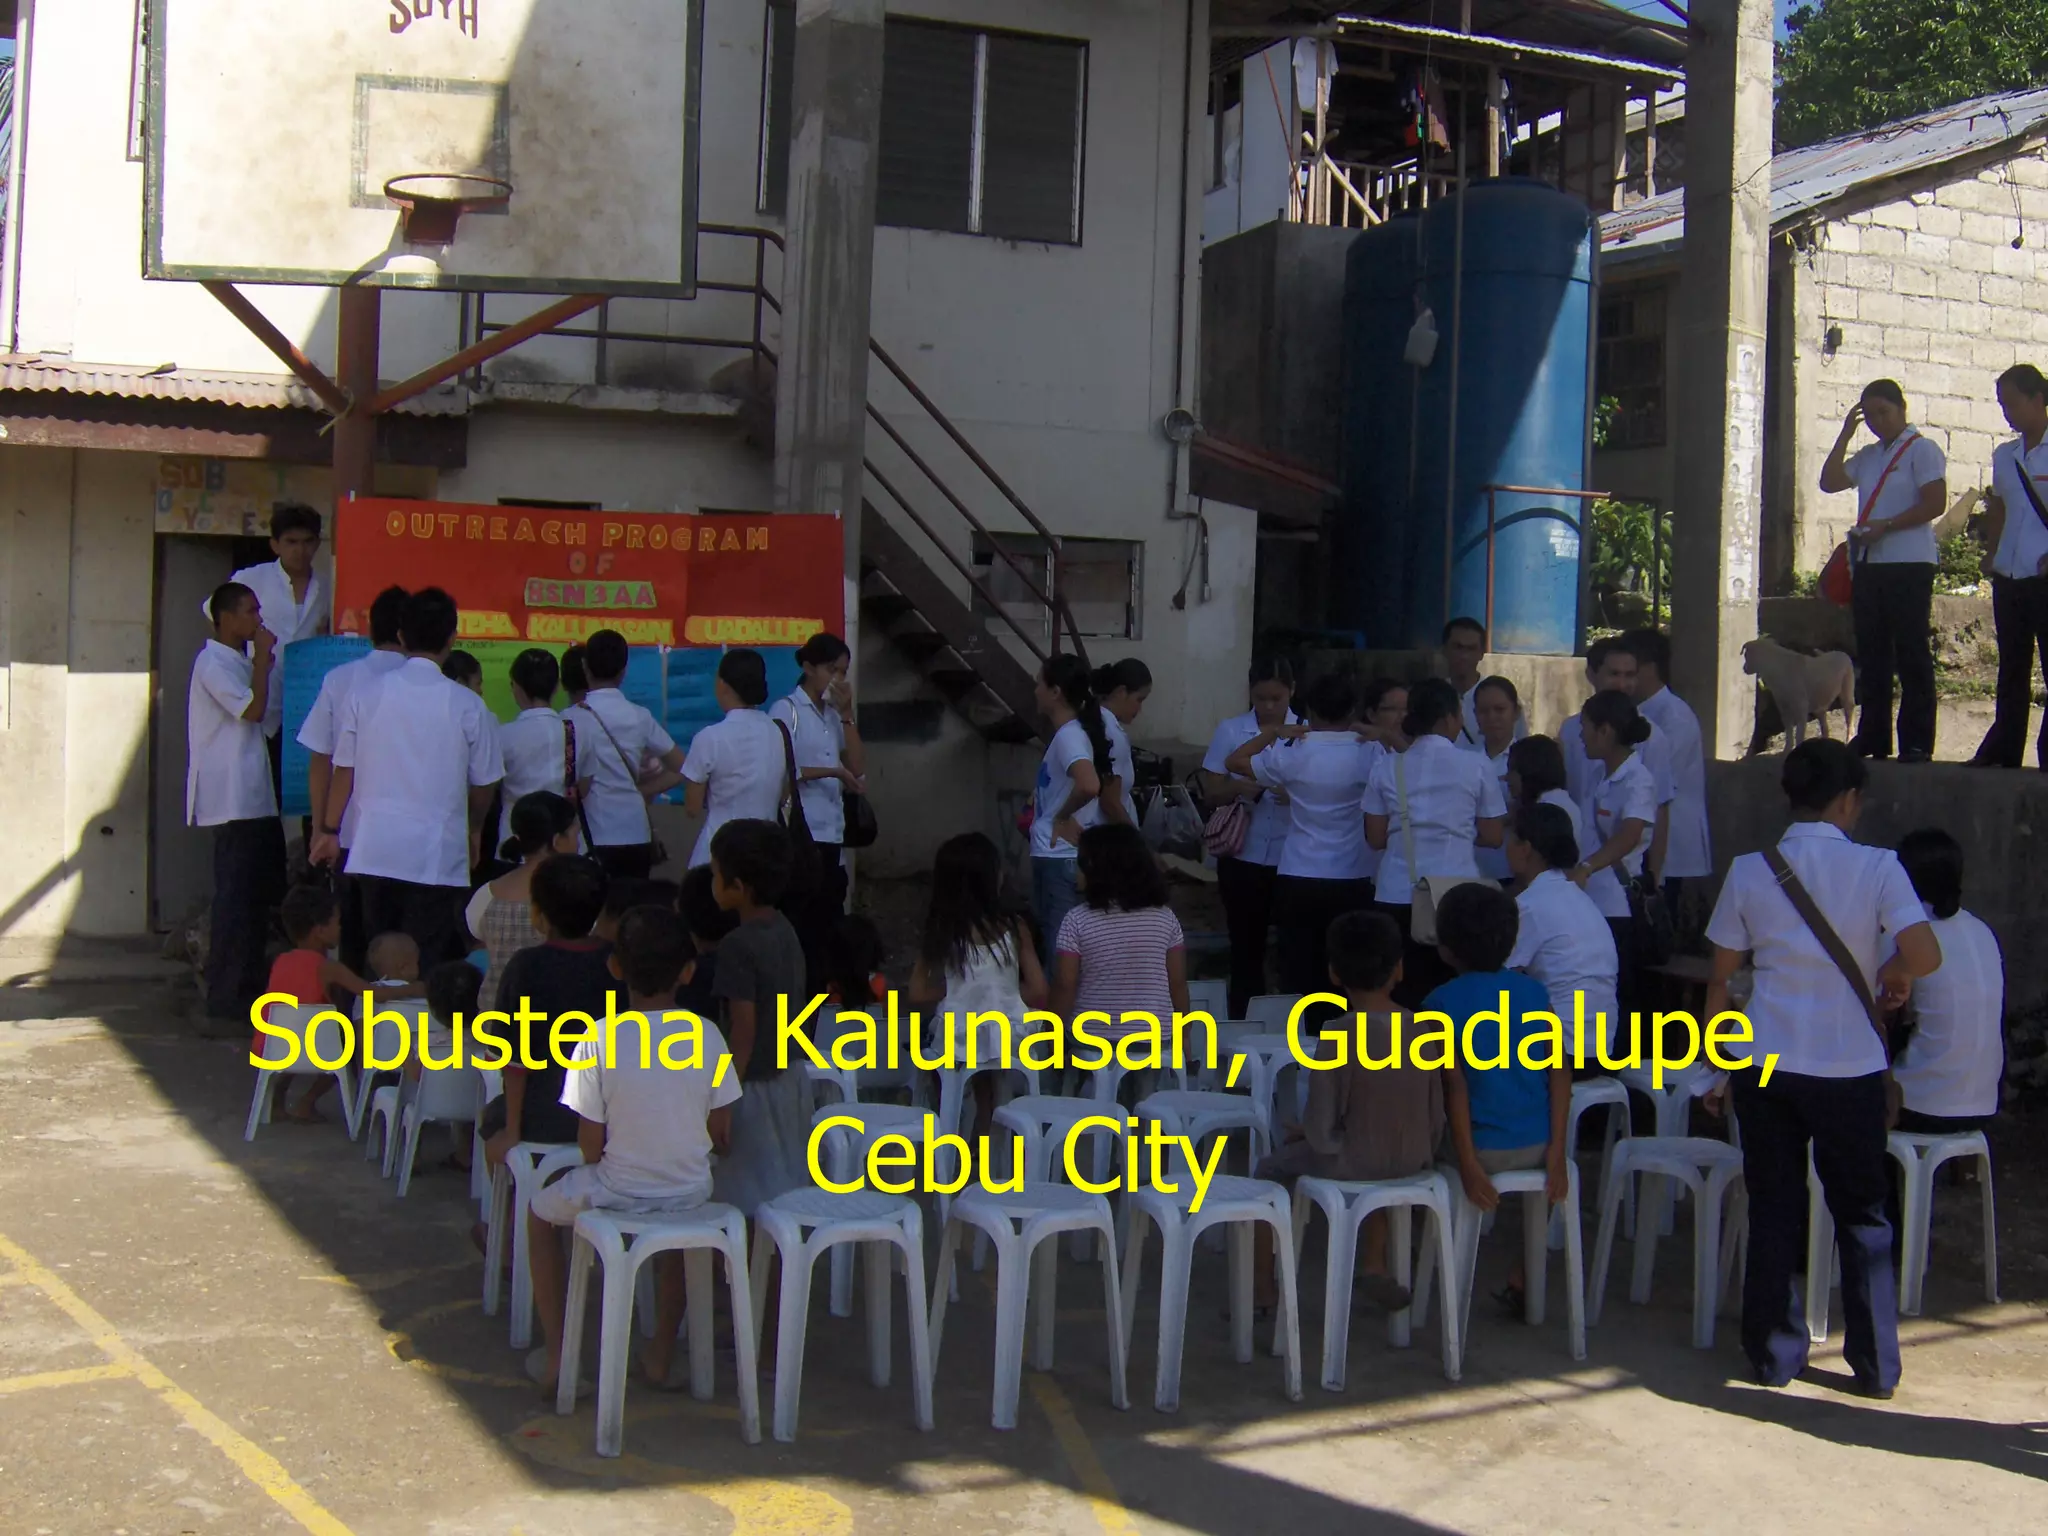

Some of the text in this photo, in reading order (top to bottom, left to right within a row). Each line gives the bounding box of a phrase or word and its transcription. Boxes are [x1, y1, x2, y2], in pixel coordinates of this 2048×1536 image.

[386, 510, 769, 551] OUTREACH PROGRAM
[569, 551, 614, 575] OF
